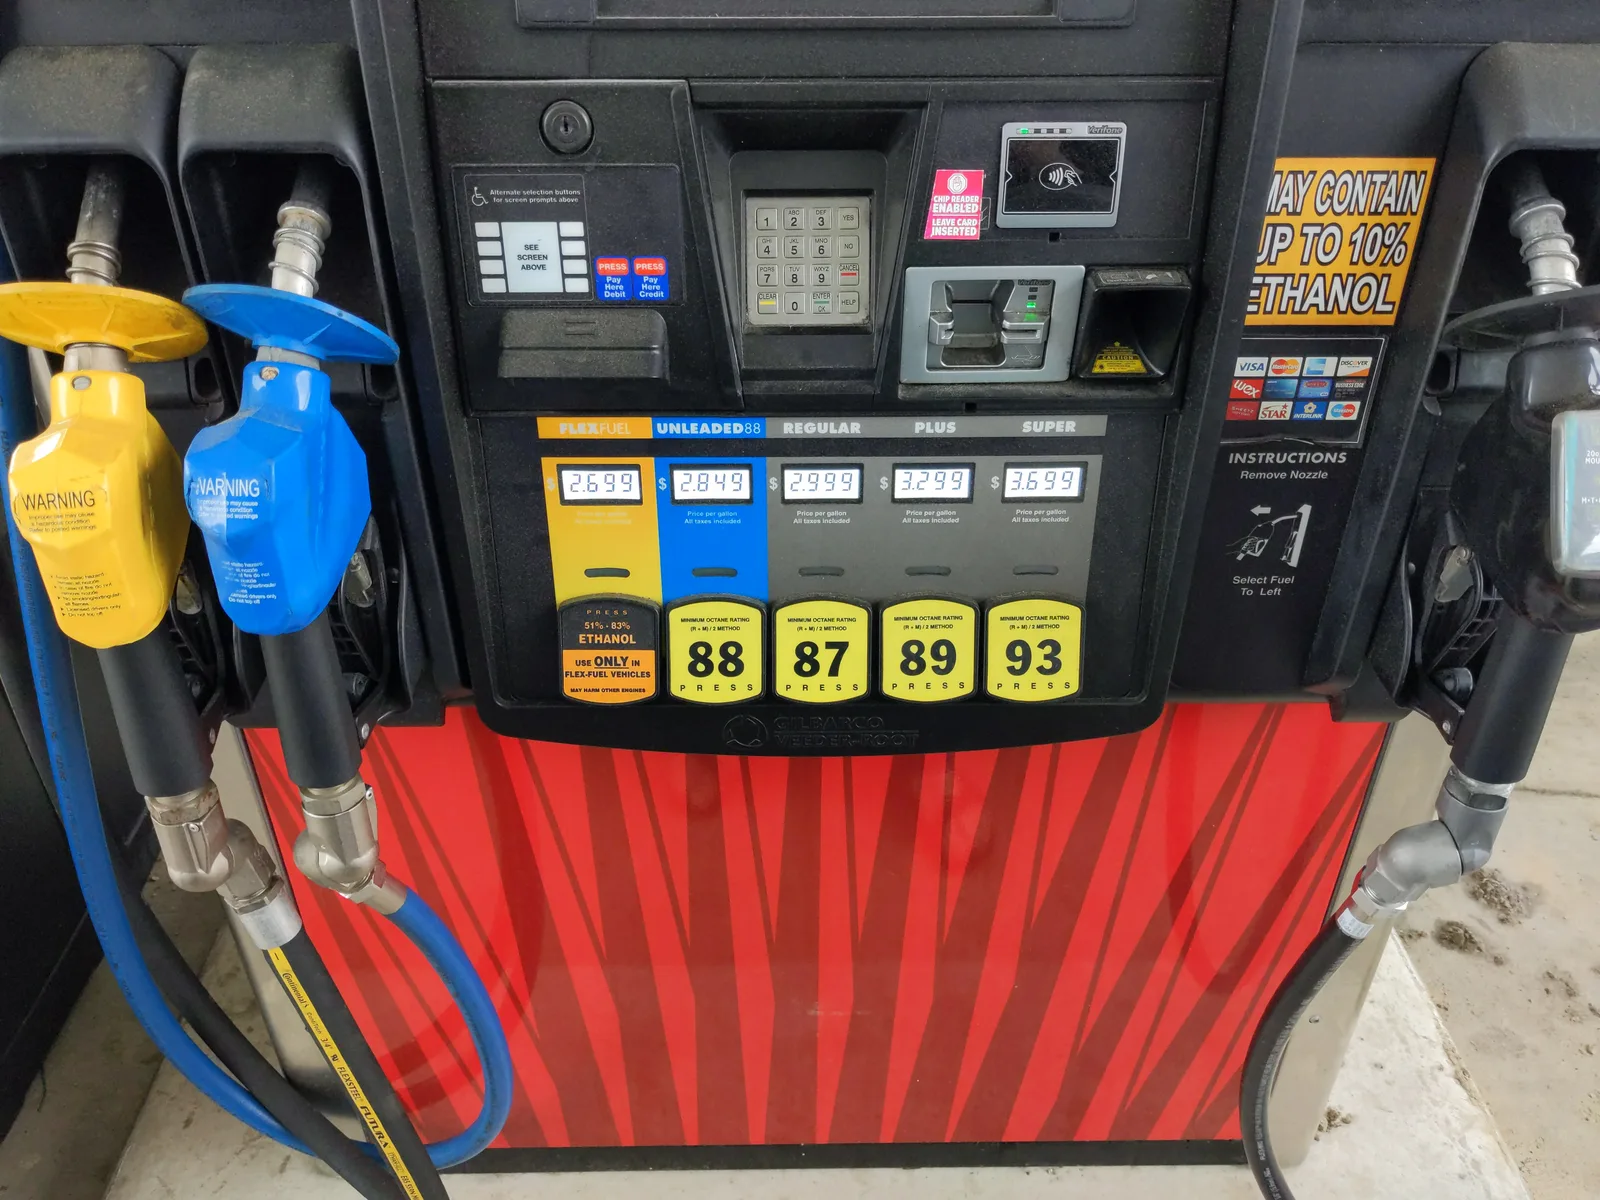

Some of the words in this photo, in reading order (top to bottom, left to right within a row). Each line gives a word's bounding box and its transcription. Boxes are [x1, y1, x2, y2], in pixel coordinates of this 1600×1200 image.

[1087, 124, 1123, 135] Verifone
[1314, 170, 1427, 216] CONTAIN
[933, 195, 950, 203] CHIP
[951, 195, 979, 203] READER
[932, 203, 979, 213] ENABLED
[764, 217, 769, 227] 1
[790, 217, 797, 227] 2
[818, 217, 825, 227] 3
[932, 218, 956, 226] LEAVE
[956, 218, 978, 226] CARD
[931, 226, 977, 236] INSERTED
[1300, 223, 1343, 265] TO
[1350, 222, 1411, 267] 10%
[763, 245, 771, 255] 4
[791, 245, 798, 255] 5
[818, 245, 825, 255] 6
[598, 263, 627, 271] PRESS
[635, 263, 664, 271] PRESS
[606, 276, 621, 284] Pay
[643, 276, 658, 284] Pay
[764, 273, 771, 283] 7
[791, 273, 798, 283] 8
[818, 273, 825, 283] 9
[1246, 273, 1396, 315] ETHANOL
[791, 301, 798, 311] 0
[1240, 362, 1265, 372] VISA
[1261, 409, 1287, 419] STAR
[559, 422, 631, 435] FLEXFUEL
[783, 422, 861, 434] REGULAR
[914, 421, 956, 434] PLUS
[1022, 420, 1076, 433] SUPER
[1228, 452, 1347, 464] INSTRUCTIONS
[1240, 470, 1287, 480] Remove
[1289, 470, 1328, 480] Nozzle
[546, 476, 556, 491] $
[569, 473, 633, 493] 2.699
[658, 477, 667, 491] $
[680, 472, 743, 492] 2.849
[769, 476, 778, 491] $
[790, 472, 853, 492] 2.999
[879, 476, 889, 491] $
[901, 471, 963, 491] 3.299
[990, 476, 1000, 490] $
[1011, 471, 1074, 491] 3.699
[195, 477, 261, 498] WARNING
[21, 490, 96, 511] WARNING
[1232, 576, 1267, 585] Select
[1270, 576, 1295, 585] Fuel
[1240, 588, 1254, 596] To
[1260, 587, 1282, 596] Left
[584, 621, 604, 630] 51%
[611, 621, 631, 630] 83%
[578, 633, 637, 644] ETHANOL
[575, 659, 592, 667] USE
[594, 655, 629, 667] ONLY
[631, 659, 640, 667] IN
[687, 640, 745, 678] 88
[793, 640, 850, 678] 87
[899, 638, 957, 676] 89
[1005, 638, 1063, 676] 93
[680, 684, 753, 692] PRESS
[785, 684, 858, 692] PRESS
[892, 682, 965, 690] PRESS
[997, 682, 1070, 690] PRESS
[773, 715, 885, 730] GILBARCO
[282, 972, 307, 1004] Continental
[337, 1066, 361, 1100] FLEXSTEEL
[360, 1105, 389, 1149] FUTURA
